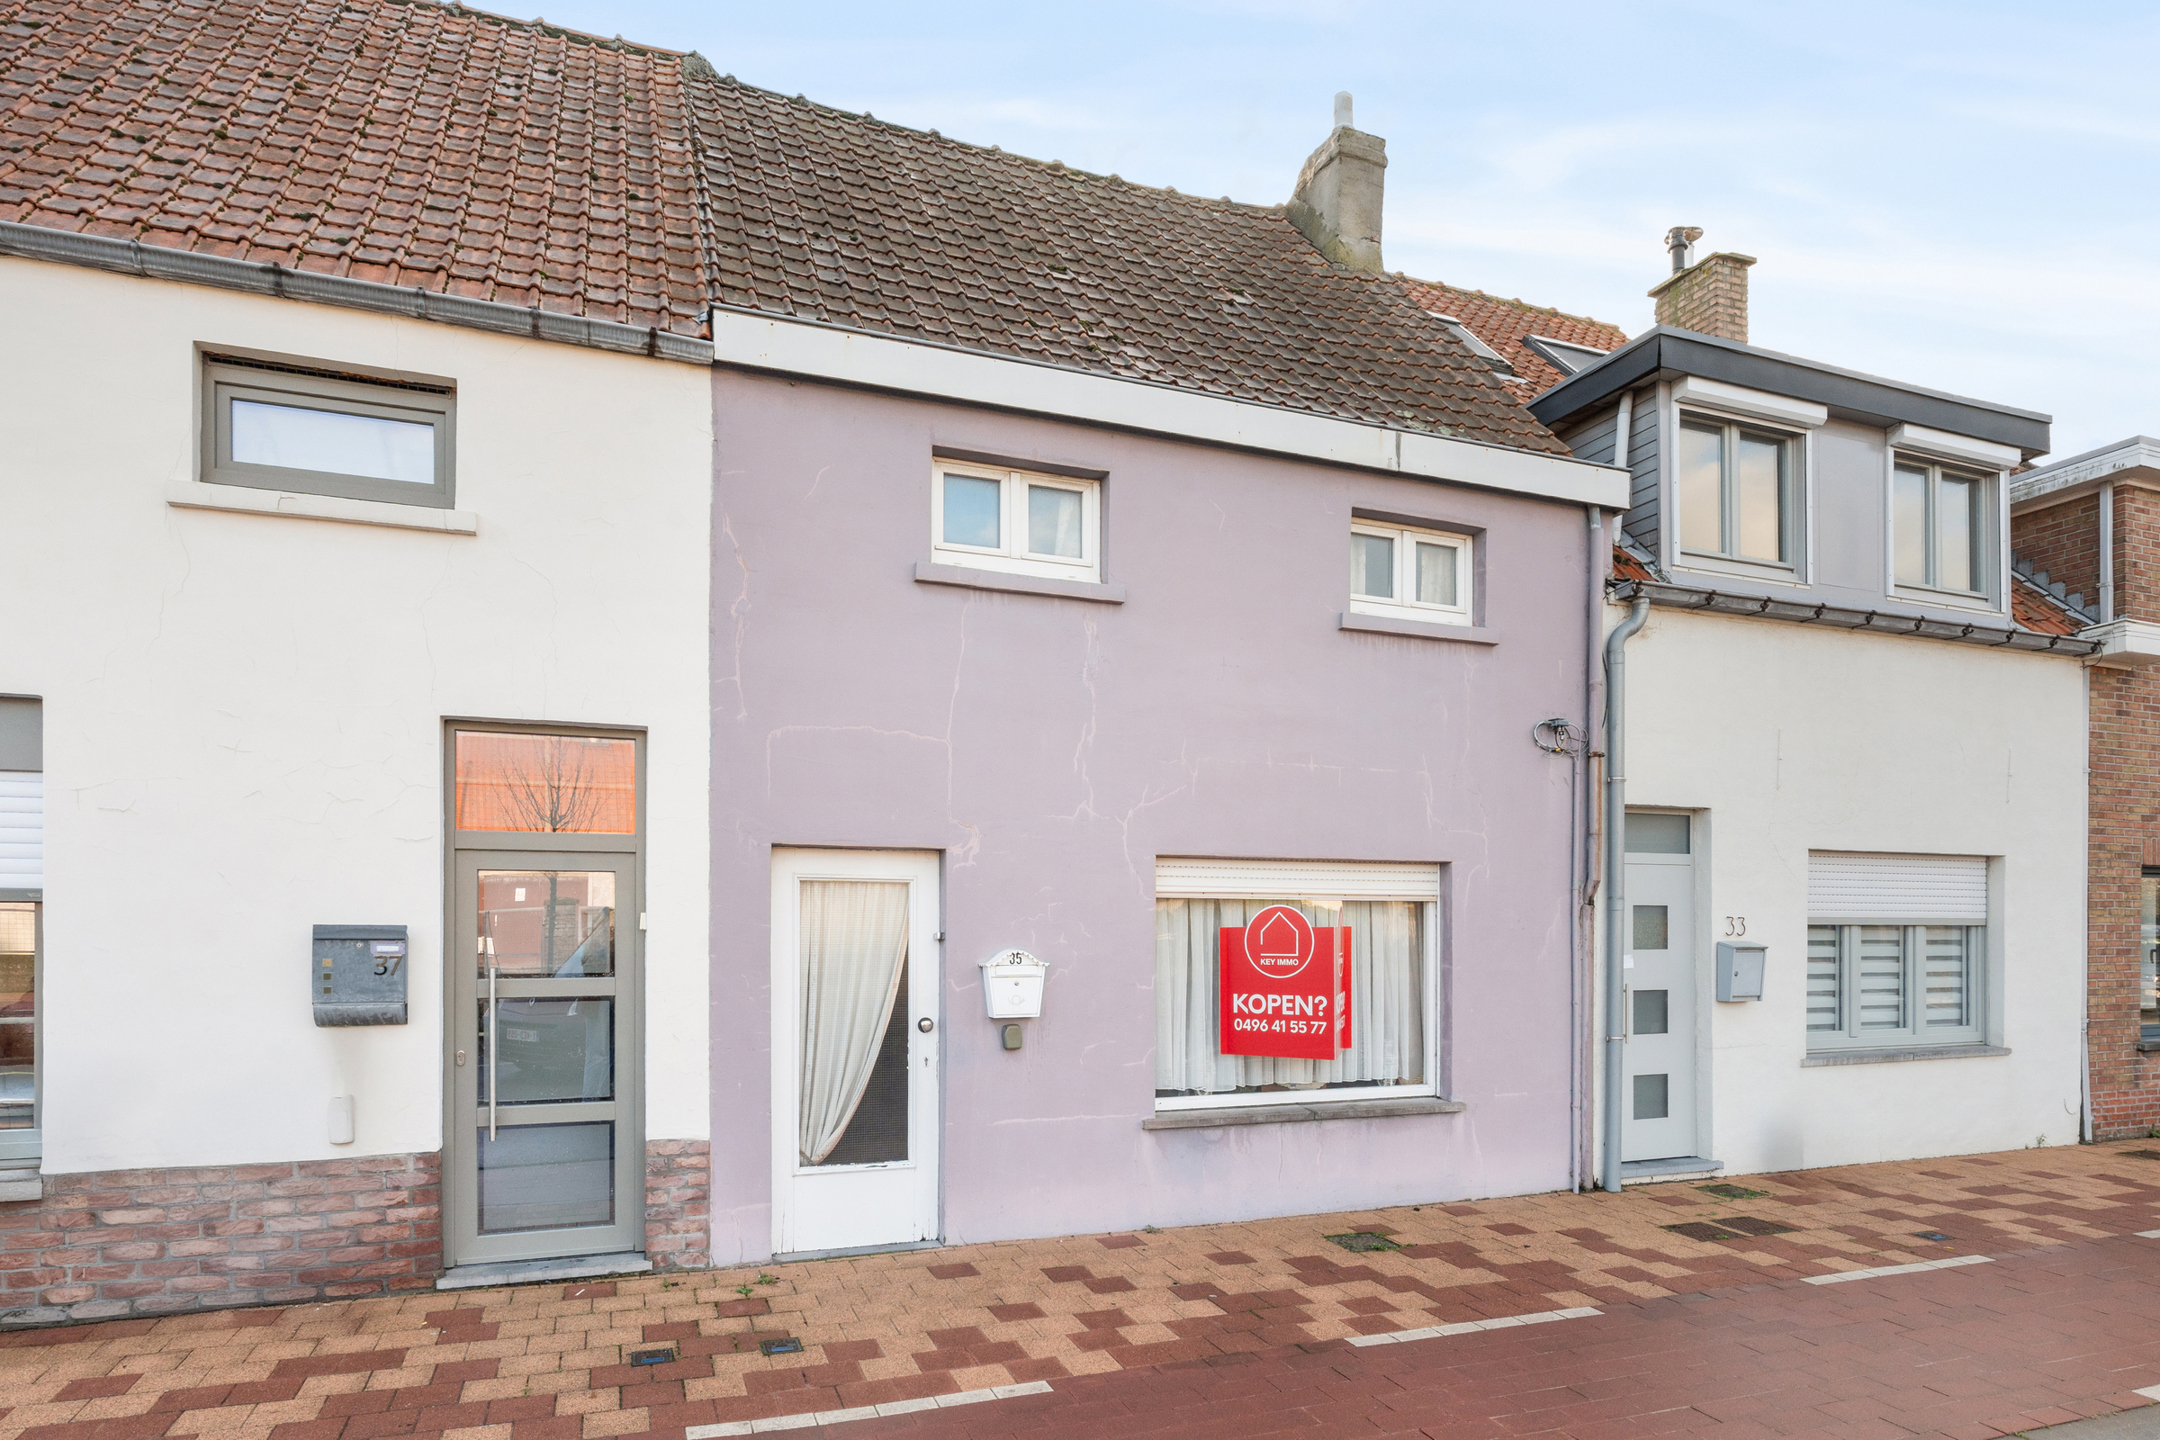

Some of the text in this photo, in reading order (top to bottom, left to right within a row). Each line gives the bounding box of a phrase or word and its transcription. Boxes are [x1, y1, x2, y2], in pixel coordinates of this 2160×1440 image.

[1725, 916, 1746, 937] 33
[373, 955, 403, 976] 37
[1009, 952, 1022, 965] 35
[1260, 958, 1299, 966] KEY IMMO
[1233, 993, 1328, 1017] KOPEN?
[1234, 1018, 1269, 1032] 0496
[1271, 1019, 1286, 1033] 41
[1290, 1020, 1308, 1034] 55
[1310, 1021, 1327, 1034] 77
